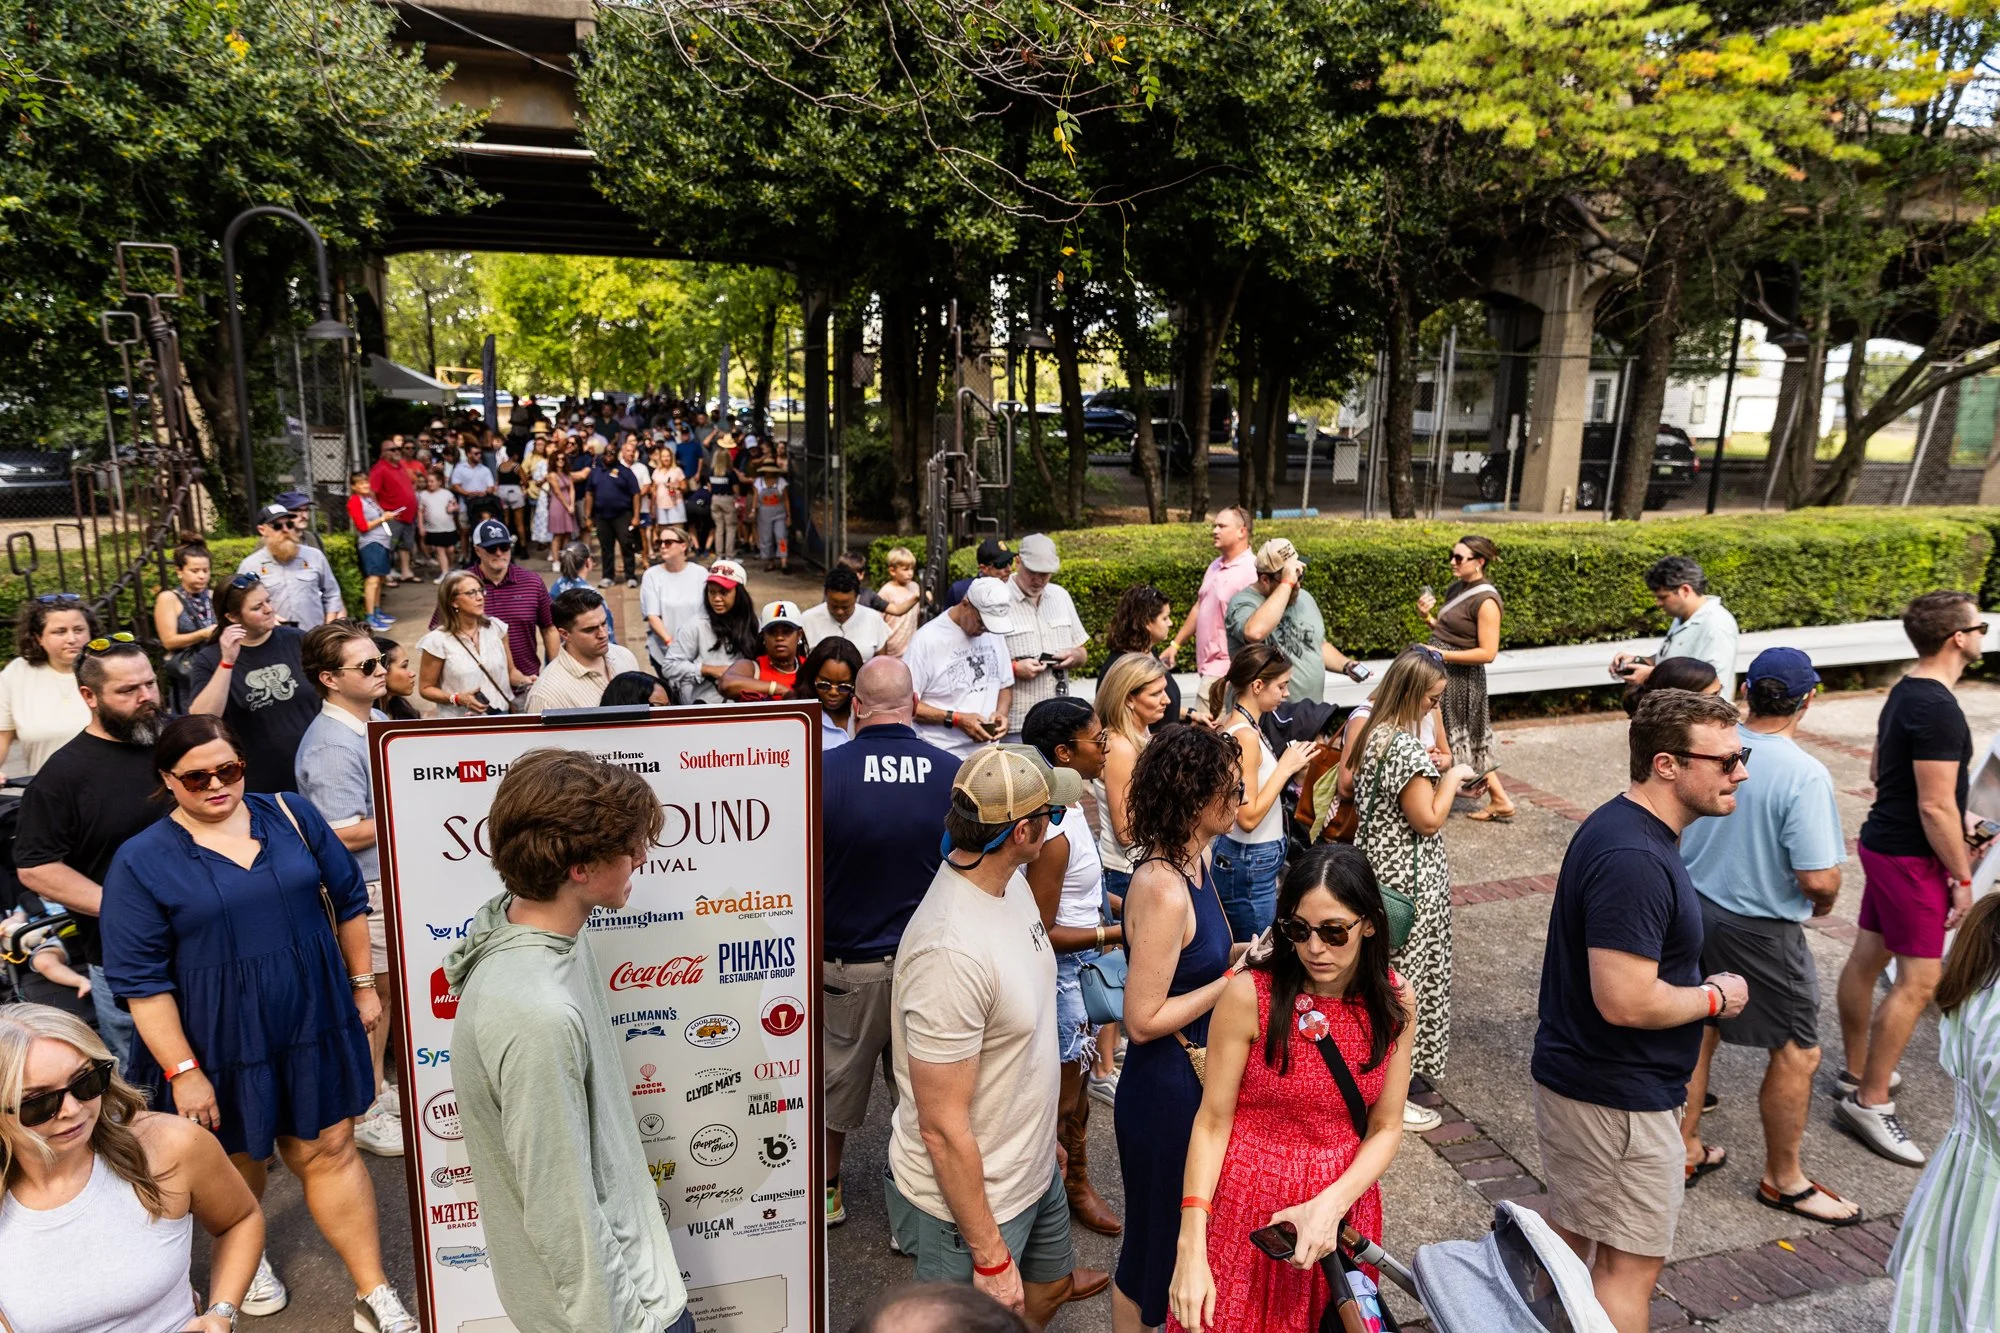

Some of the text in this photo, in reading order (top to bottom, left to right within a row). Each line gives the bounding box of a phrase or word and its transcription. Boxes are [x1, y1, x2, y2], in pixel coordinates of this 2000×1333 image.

[613, 751, 644, 759] Home
[680, 747, 790, 769] Southern Living
[864, 755, 932, 783] ASAP
[738, 909, 793, 920] CREDIT UNION
[719, 936, 795, 973] PIHAKIS
[609, 954, 709, 991] Coca-Cola
[719, 967, 795, 984] RESTAURANT GROUP
[611, 1006, 677, 1027] HELLMANN'S
[690, 1018, 709, 1030] GOOD
[754, 1059, 800, 1080] OTMJ
[632, 1088, 666, 1096] BUDDIES
[636, 1082, 662, 1090] BOOCH
[686, 1082, 714, 1102] CLYDE
[715, 1071, 742, 1092] MAY'S
[749, 1094, 763, 1102] THIS
[693, 1137, 722, 1150] Pepper
[711, 1142, 735, 1153] Place
[778, 1133, 797, 1150] BETTER
[758, 1151, 791, 1168] KOMBUCHA
[686, 1183, 717, 1194] HOODOO
[751, 1188, 806, 1203] Campesino
[685, 1186, 743, 1210] espresso
[721, 1196, 743, 1204] VODKA
[447, 1221, 477, 1230] BRANDS
[687, 1217, 734, 1236] VULCAN
[732, 1220, 807, 1236] CULINARY SCIENCE CENTER
[704, 1231, 720, 1241] GIN
[710, 1304, 737, 1313] Anderton
[697, 1310, 744, 1323] Michael Patterson
